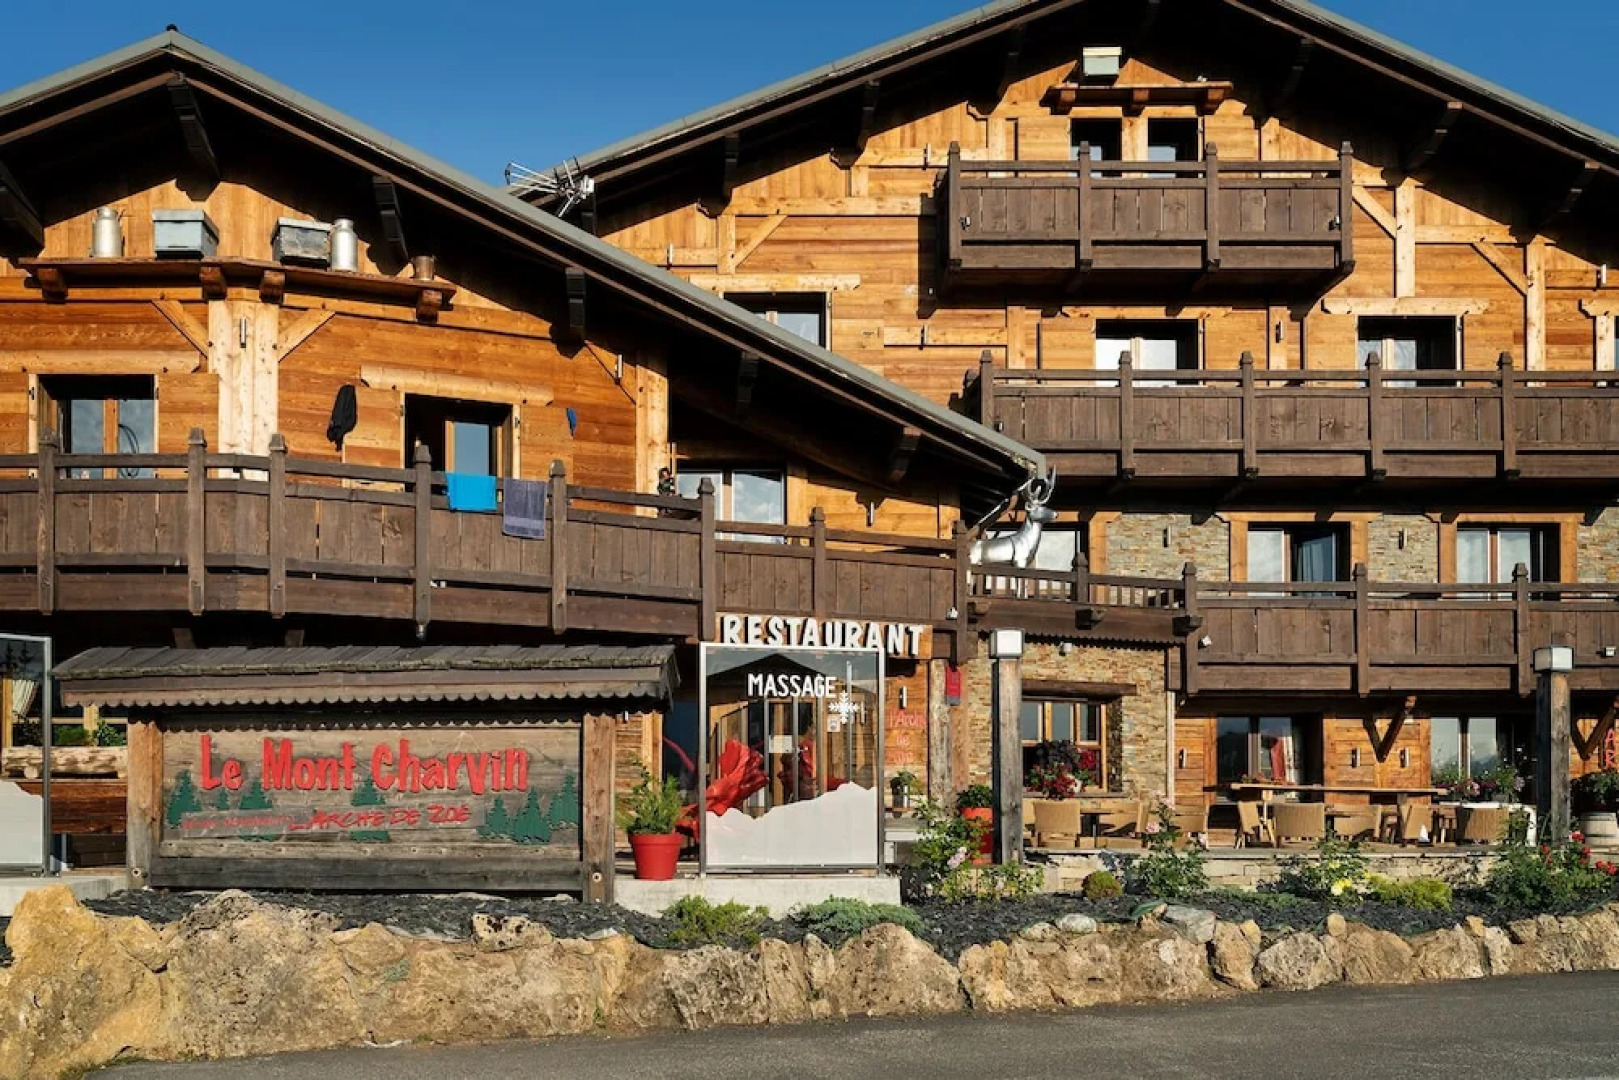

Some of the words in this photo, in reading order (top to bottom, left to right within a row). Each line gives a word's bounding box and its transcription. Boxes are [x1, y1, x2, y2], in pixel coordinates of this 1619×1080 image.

[723, 613, 924, 656] RESTAURANT
[747, 672, 837, 699] MASSAGE
[201, 734, 244, 791] Le
[262, 737, 357, 791] Mont
[371, 738, 529, 795] Charvin
[388, 808, 422, 825] DE
